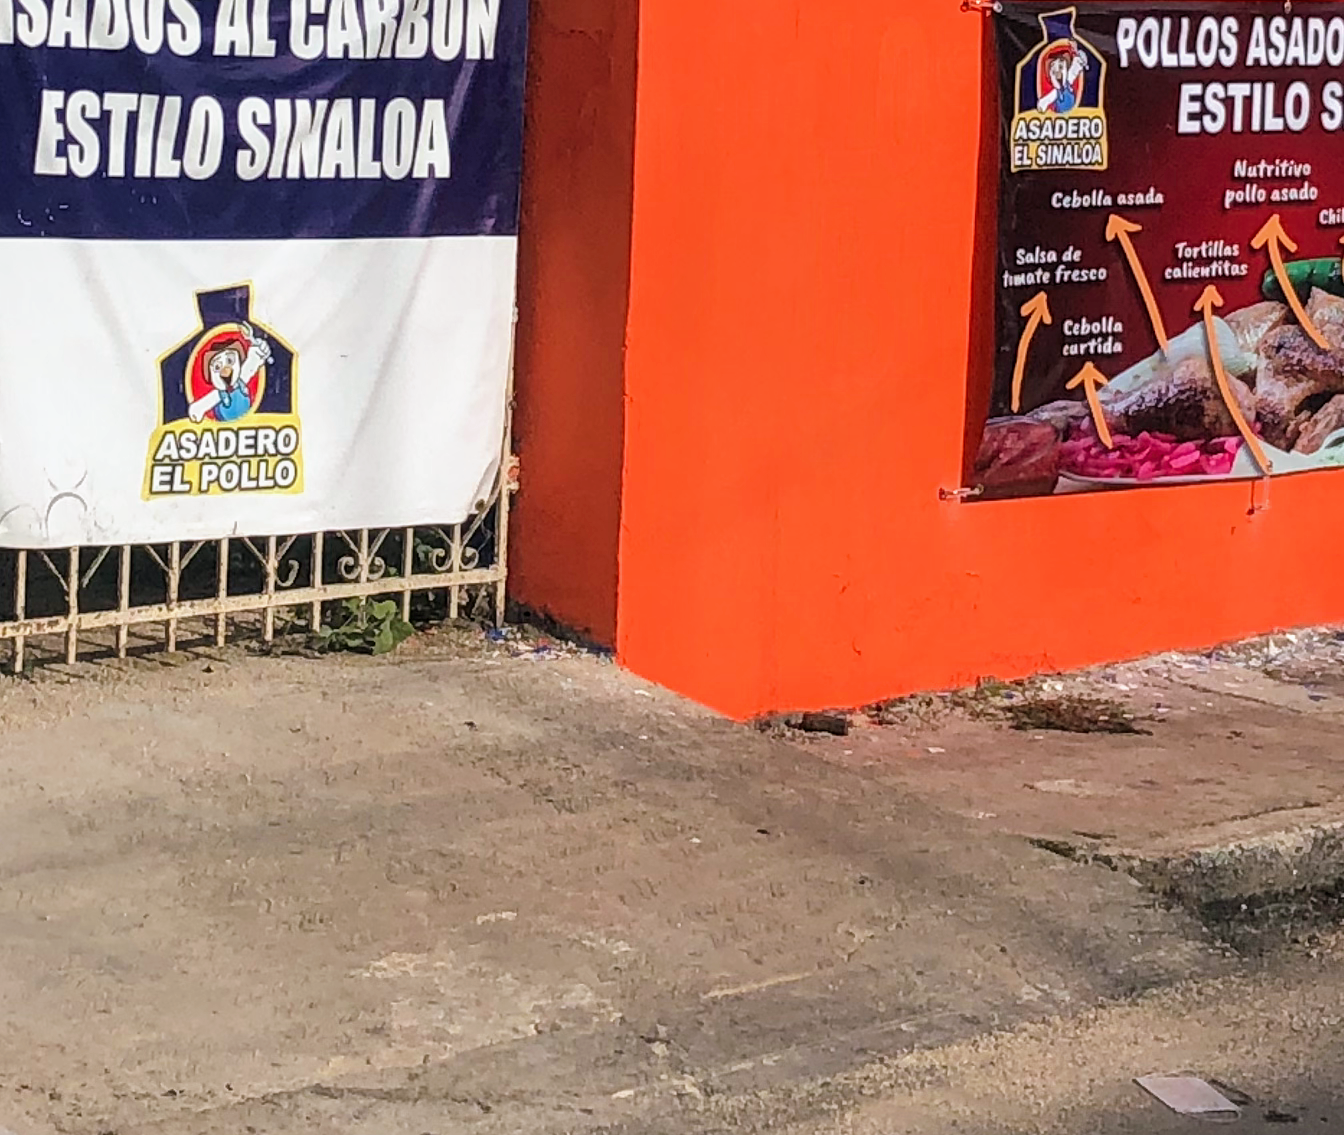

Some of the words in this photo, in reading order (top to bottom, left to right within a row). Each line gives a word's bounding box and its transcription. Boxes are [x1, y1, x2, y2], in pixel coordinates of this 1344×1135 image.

[1117, 16, 1239, 68] POLLOS
[1177, 81, 1310, 134] ESTILO
[33, 88, 226, 182] ESTILO
[235, 97, 453, 182] SINALOA
[1014, 118, 1103, 140] ASADERO
[1014, 144, 1032, 165] EL
[1036, 144, 1103, 165] SINALOA
[1234, 159, 1312, 178] Nutritivo
[1051, 189, 1112, 208] Cebolla
[1117, 186, 1164, 205] asada
[1224, 183, 1266, 209] pollo
[1270, 180, 1319, 202] asado
[1016, 246, 1057, 265] Salsa
[1062, 245, 1082, 262] de
[1175, 240, 1240, 259] Tortillas
[1054, 265, 1107, 283] fresco
[1165, 261, 1249, 279] calientitas
[1063, 316, 1123, 336] Cebolla
[154, 427, 298, 461] ASADERO
[151, 464, 191, 493] EL
[200, 459, 296, 492] POLLO
